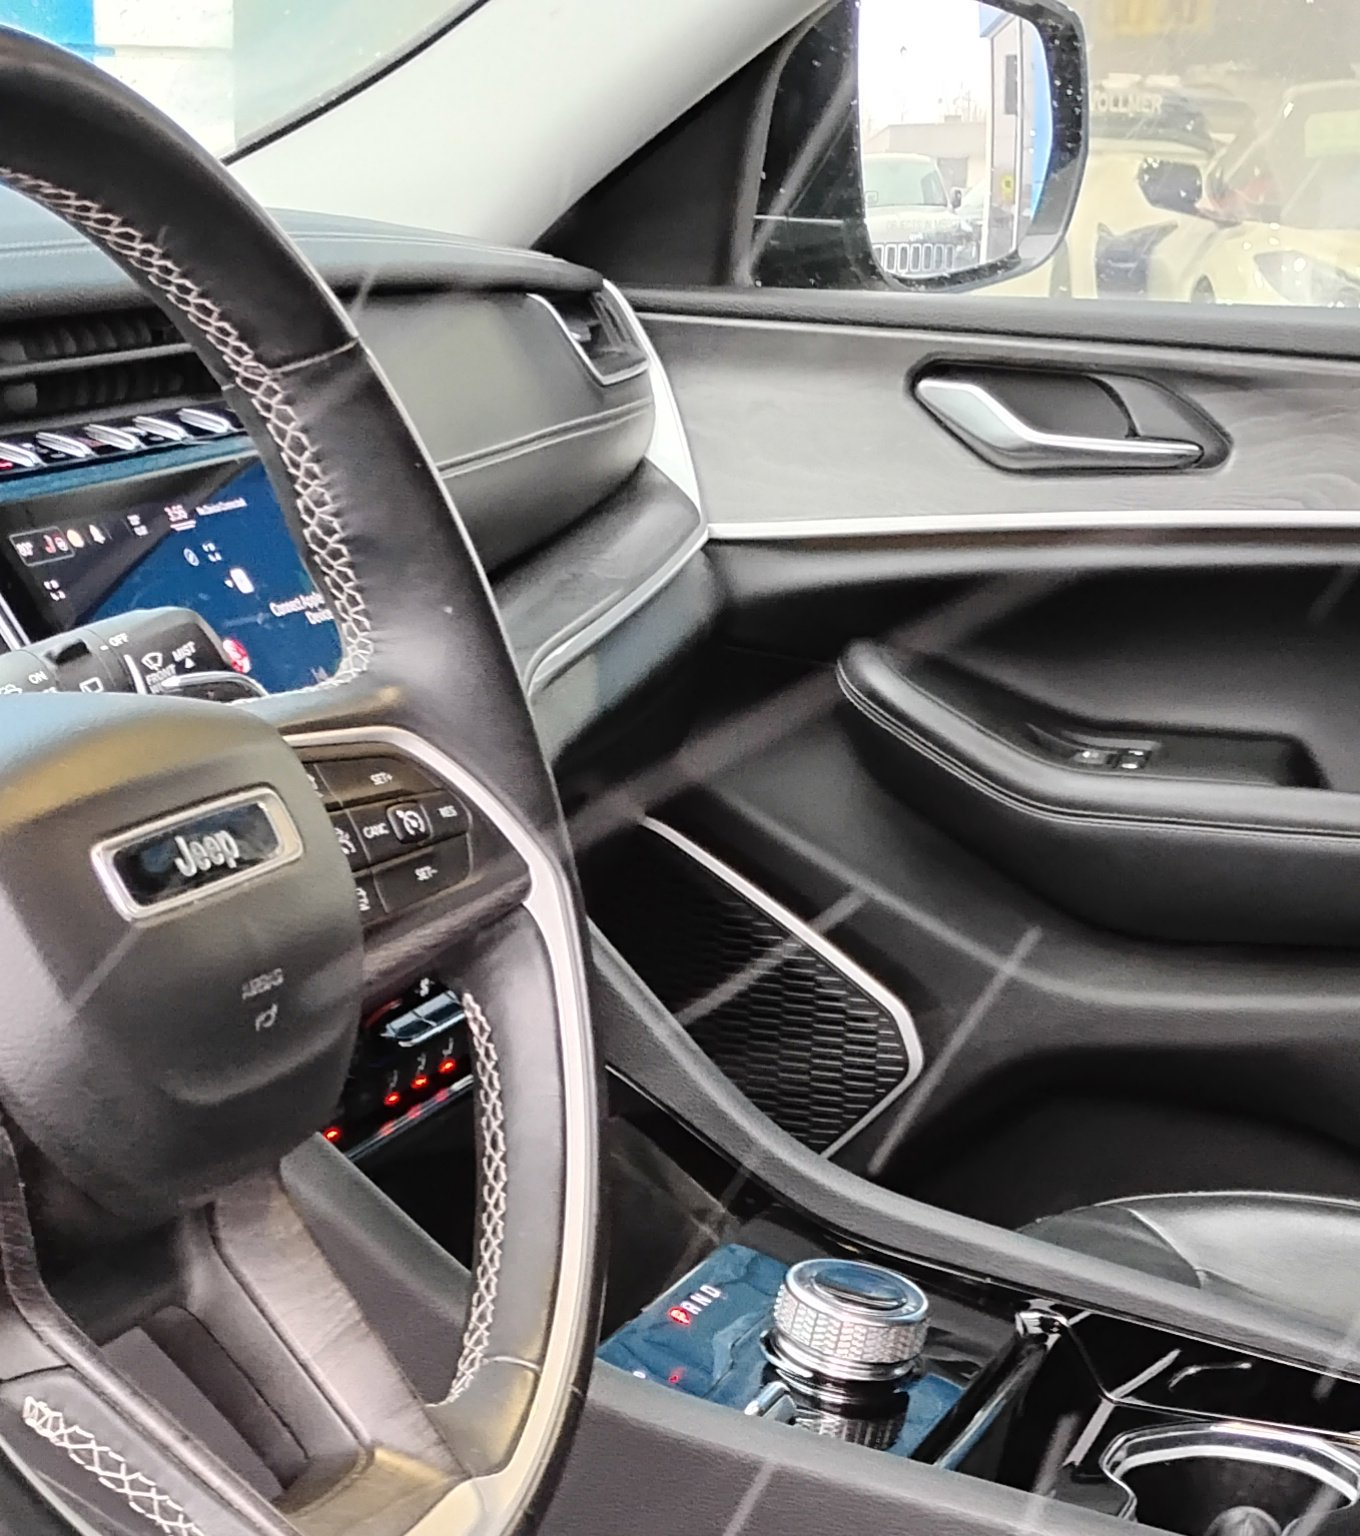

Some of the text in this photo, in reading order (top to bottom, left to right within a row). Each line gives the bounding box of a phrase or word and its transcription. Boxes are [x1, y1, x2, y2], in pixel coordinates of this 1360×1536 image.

[108, 632, 130, 648] OFF
[28, 671, 47, 685] ON
[145, 664, 177, 686] FRONT
[174, 830, 240, 878] Jeep
